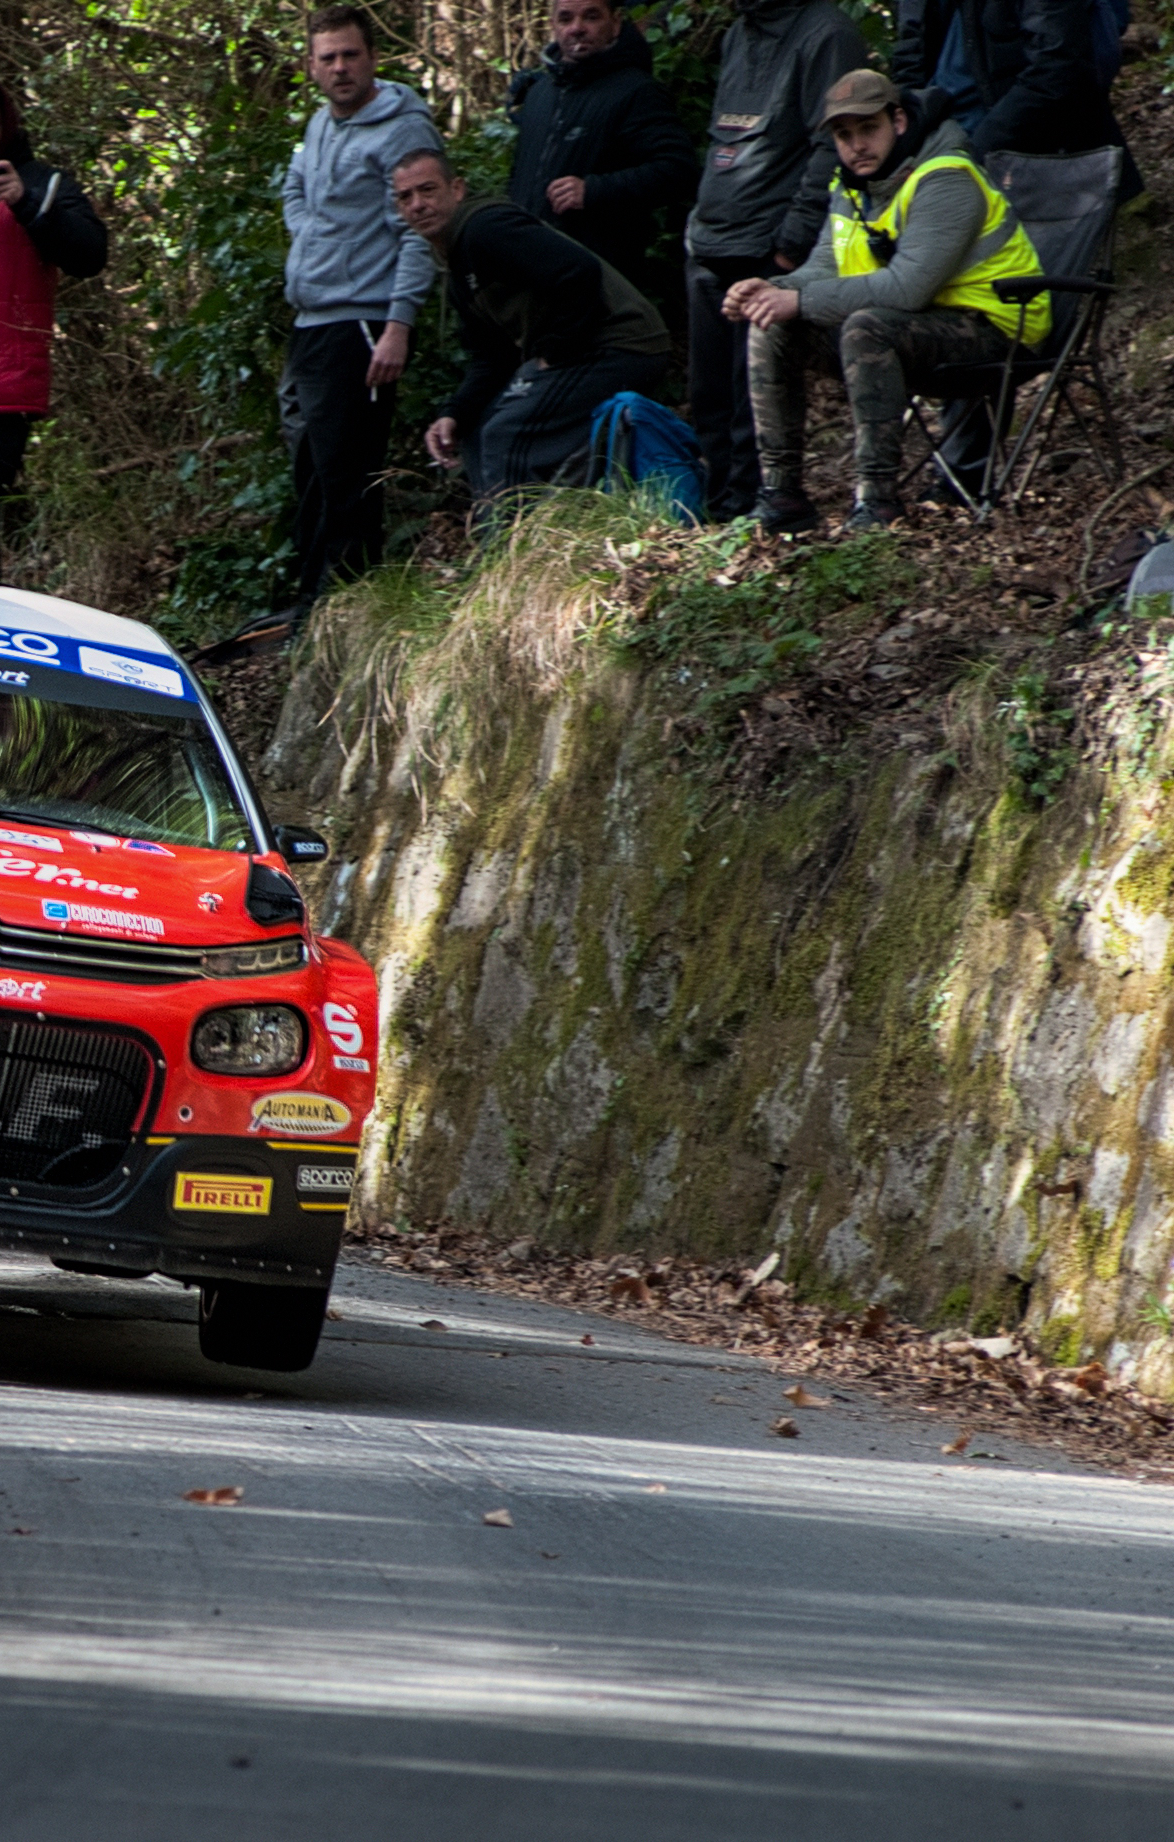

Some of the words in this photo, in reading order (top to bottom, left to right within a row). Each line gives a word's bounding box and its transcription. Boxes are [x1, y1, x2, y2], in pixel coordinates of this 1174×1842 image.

[70, 903, 165, 936] EUROCONNECTION
[253, 1099, 337, 1129] AUTOMANIA
[300, 1168, 353, 1189] sparco
[183, 1180, 264, 1208] PIRELLI
